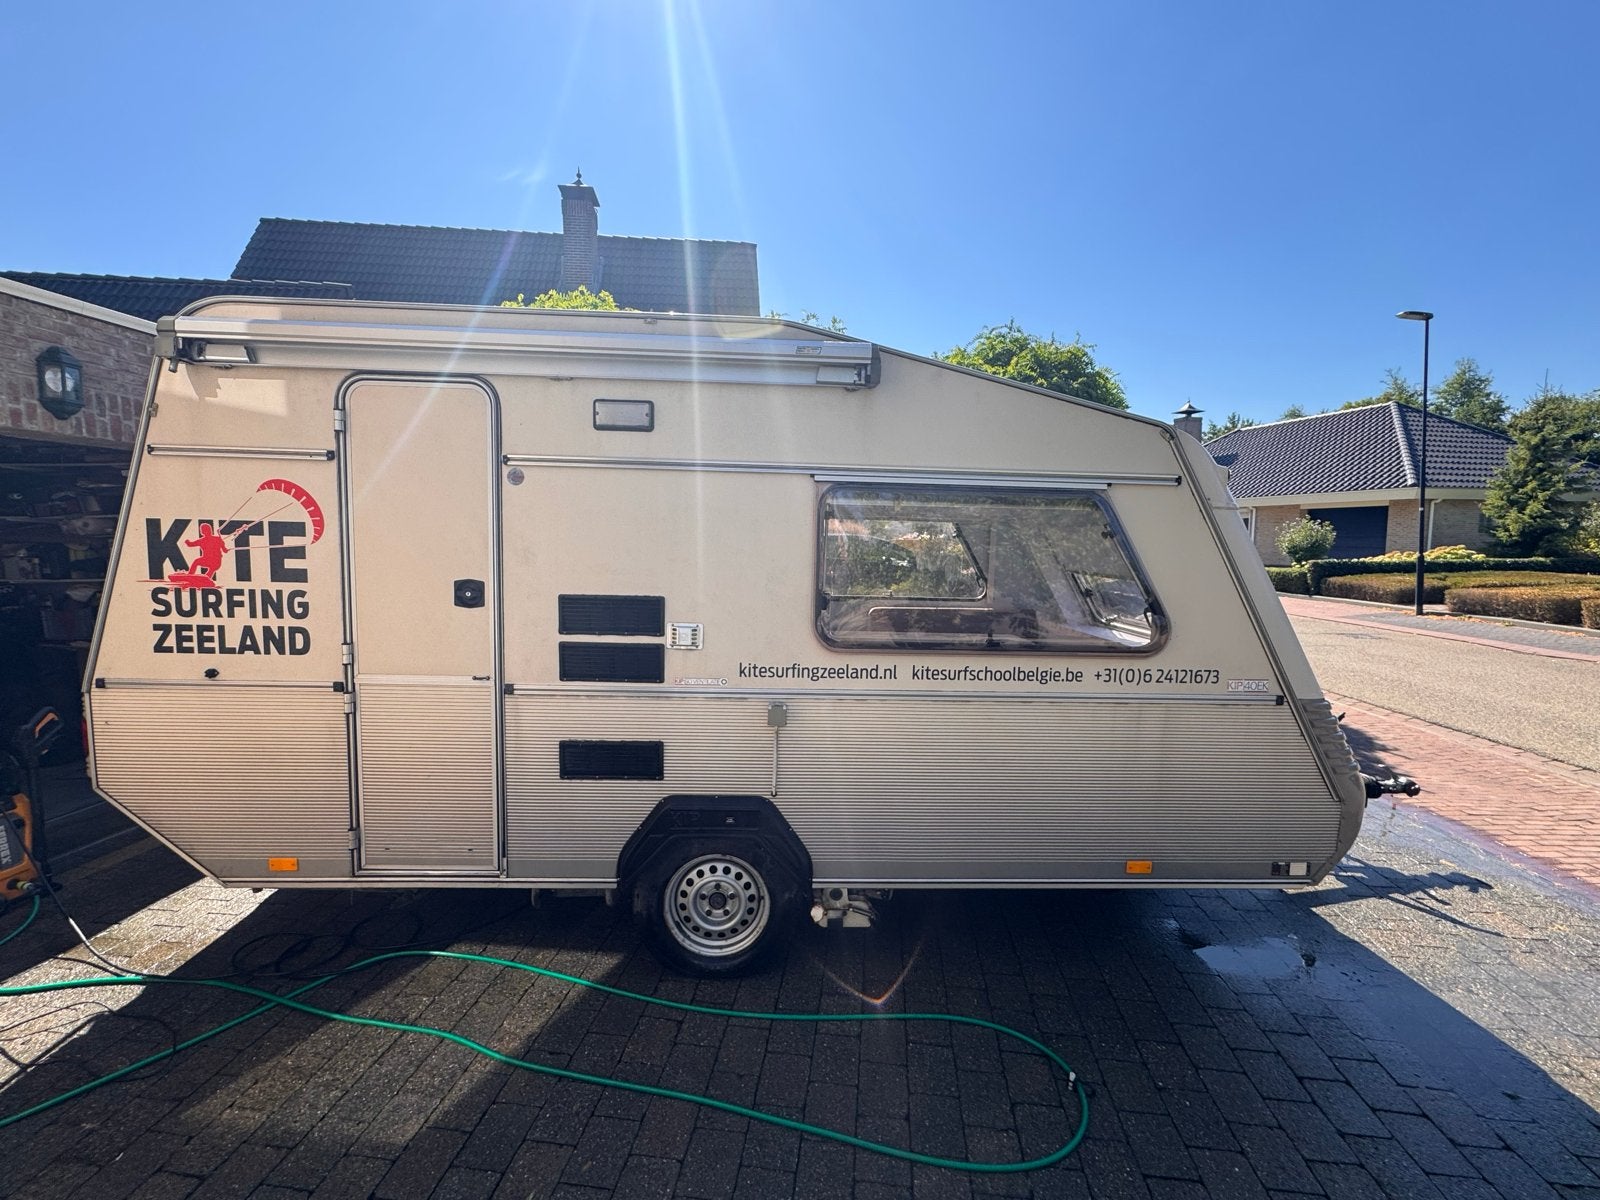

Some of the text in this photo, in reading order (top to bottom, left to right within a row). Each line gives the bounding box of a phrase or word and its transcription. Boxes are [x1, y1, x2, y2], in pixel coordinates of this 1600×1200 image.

[146, 518, 308, 582] KTE
[151, 587, 309, 619] SURFING
[152, 624, 311, 655] ZEELAND
[739, 662, 898, 682] kitesurfingzeeland.nl
[912, 665, 1084, 685] kitesurfschoolbelgie.be
[1094, 668, 1153, 686] +31(0)6
[1155, 669, 1220, 684] 24121673
